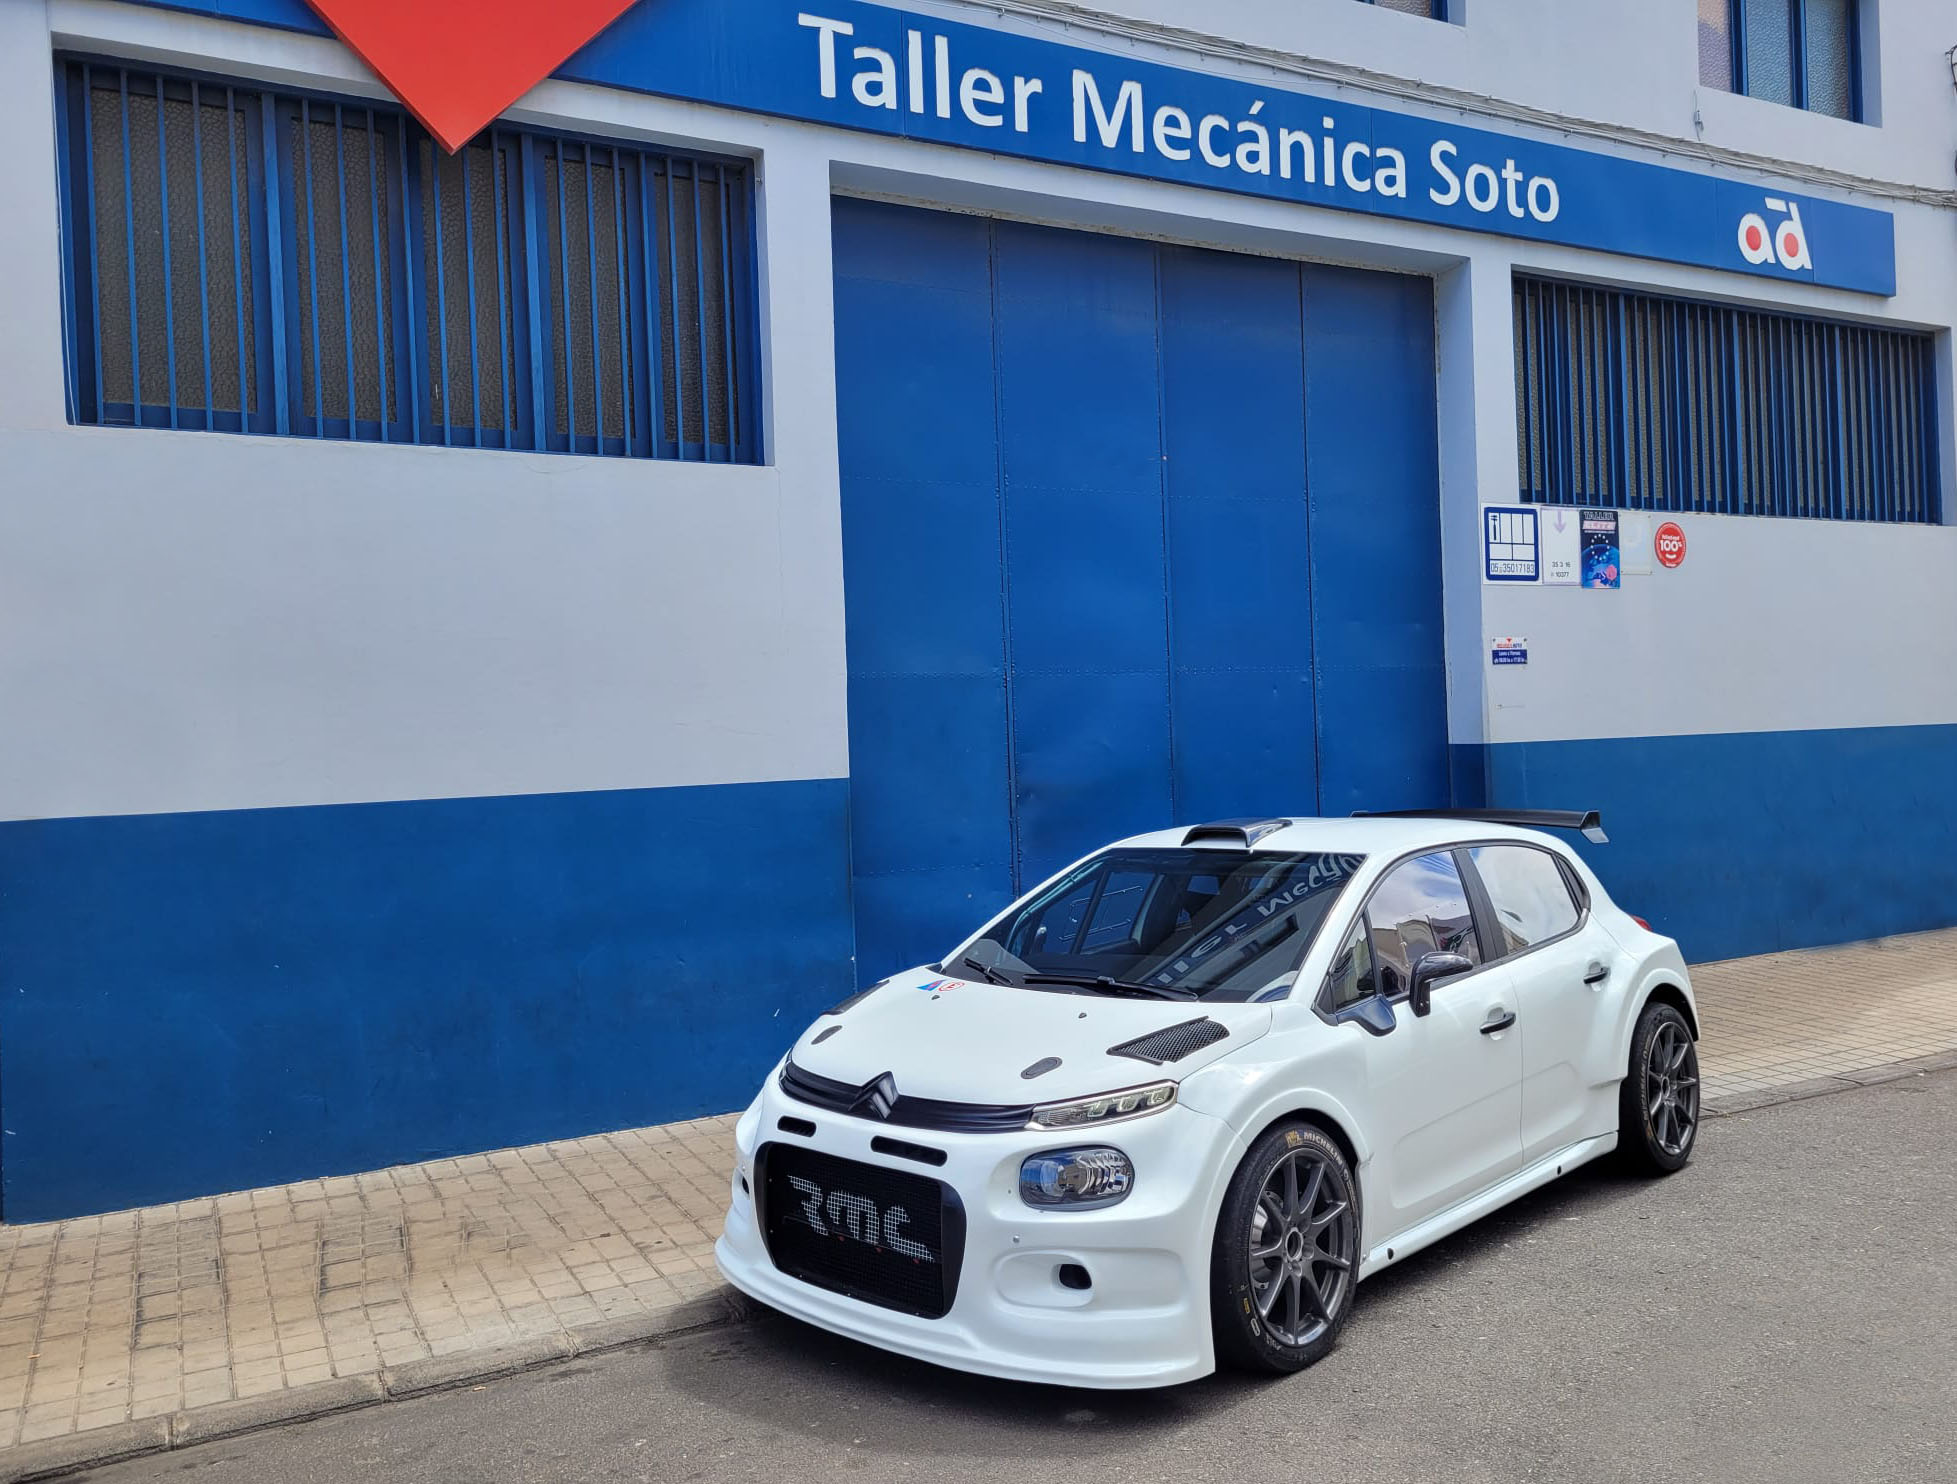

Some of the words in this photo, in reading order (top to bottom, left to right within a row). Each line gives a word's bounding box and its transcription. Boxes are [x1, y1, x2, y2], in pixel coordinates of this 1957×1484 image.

[798, 12, 1042, 133] Taller
[1072, 69, 1407, 198] Mecánica
[1429, 139, 1560, 223] Soto
[1303, 1131, 1344, 1166] MICHELIN
